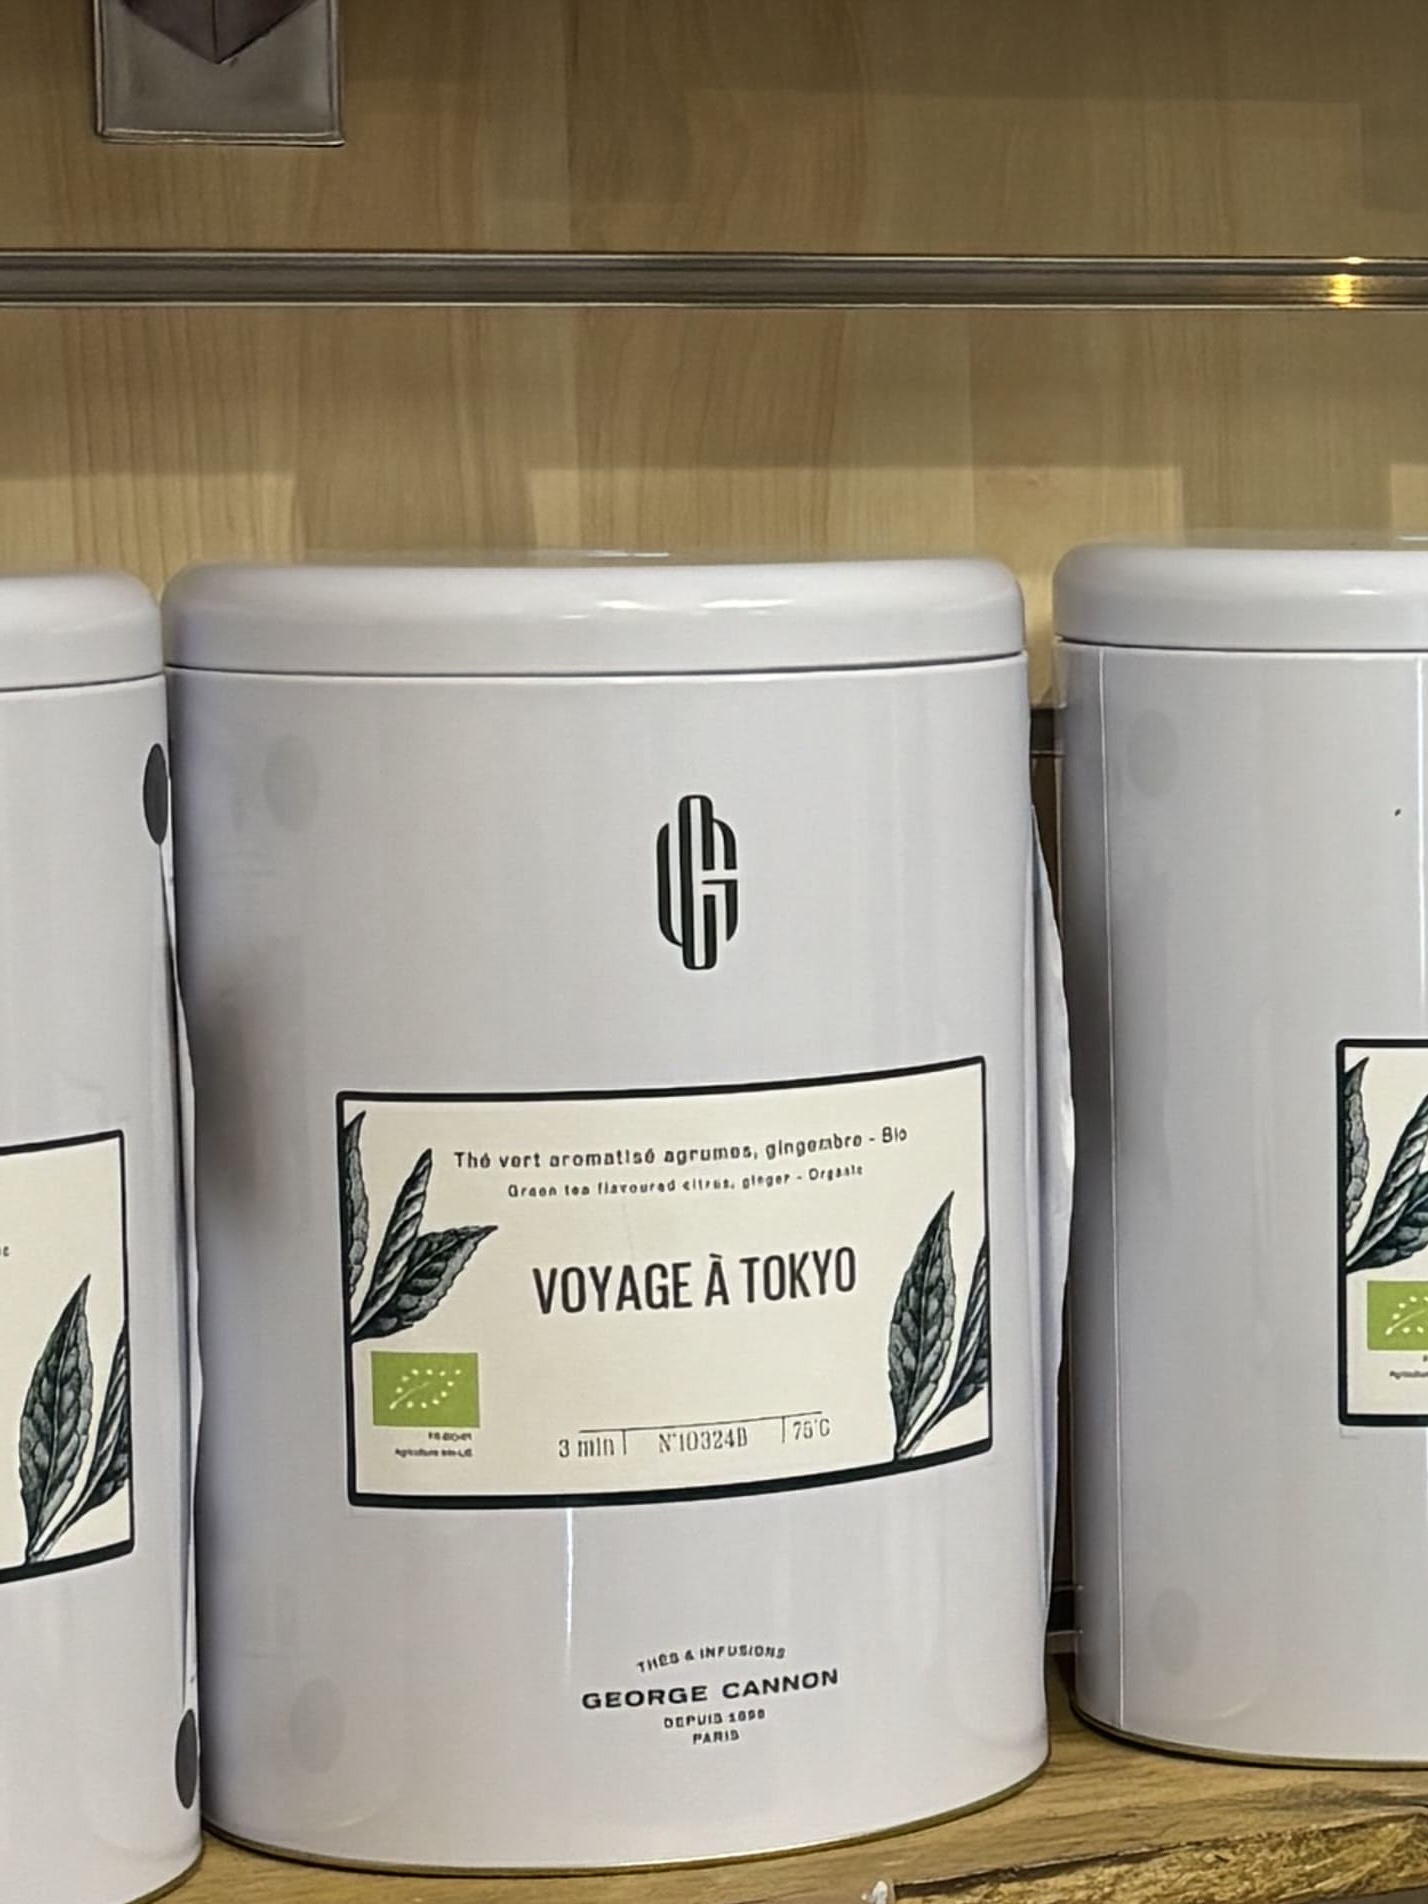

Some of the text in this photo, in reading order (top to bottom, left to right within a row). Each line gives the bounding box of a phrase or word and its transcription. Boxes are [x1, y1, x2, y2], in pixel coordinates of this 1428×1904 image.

[454, 1127, 907, 1168] Thé vert aromatisé agrumes, gingembre Bio
[532, 1247, 855, 1314] VOYAGE À TOKYO
[559, 1440, 569, 1458] 3
[578, 1437, 614, 1457] min
[700, 1645, 785, 1659] INFUSIONS
[582, 1669, 837, 1709] GEORGE CANNON
[664, 1713, 723, 1728] DEPUIS
[693, 1730, 739, 1744] PARIS
